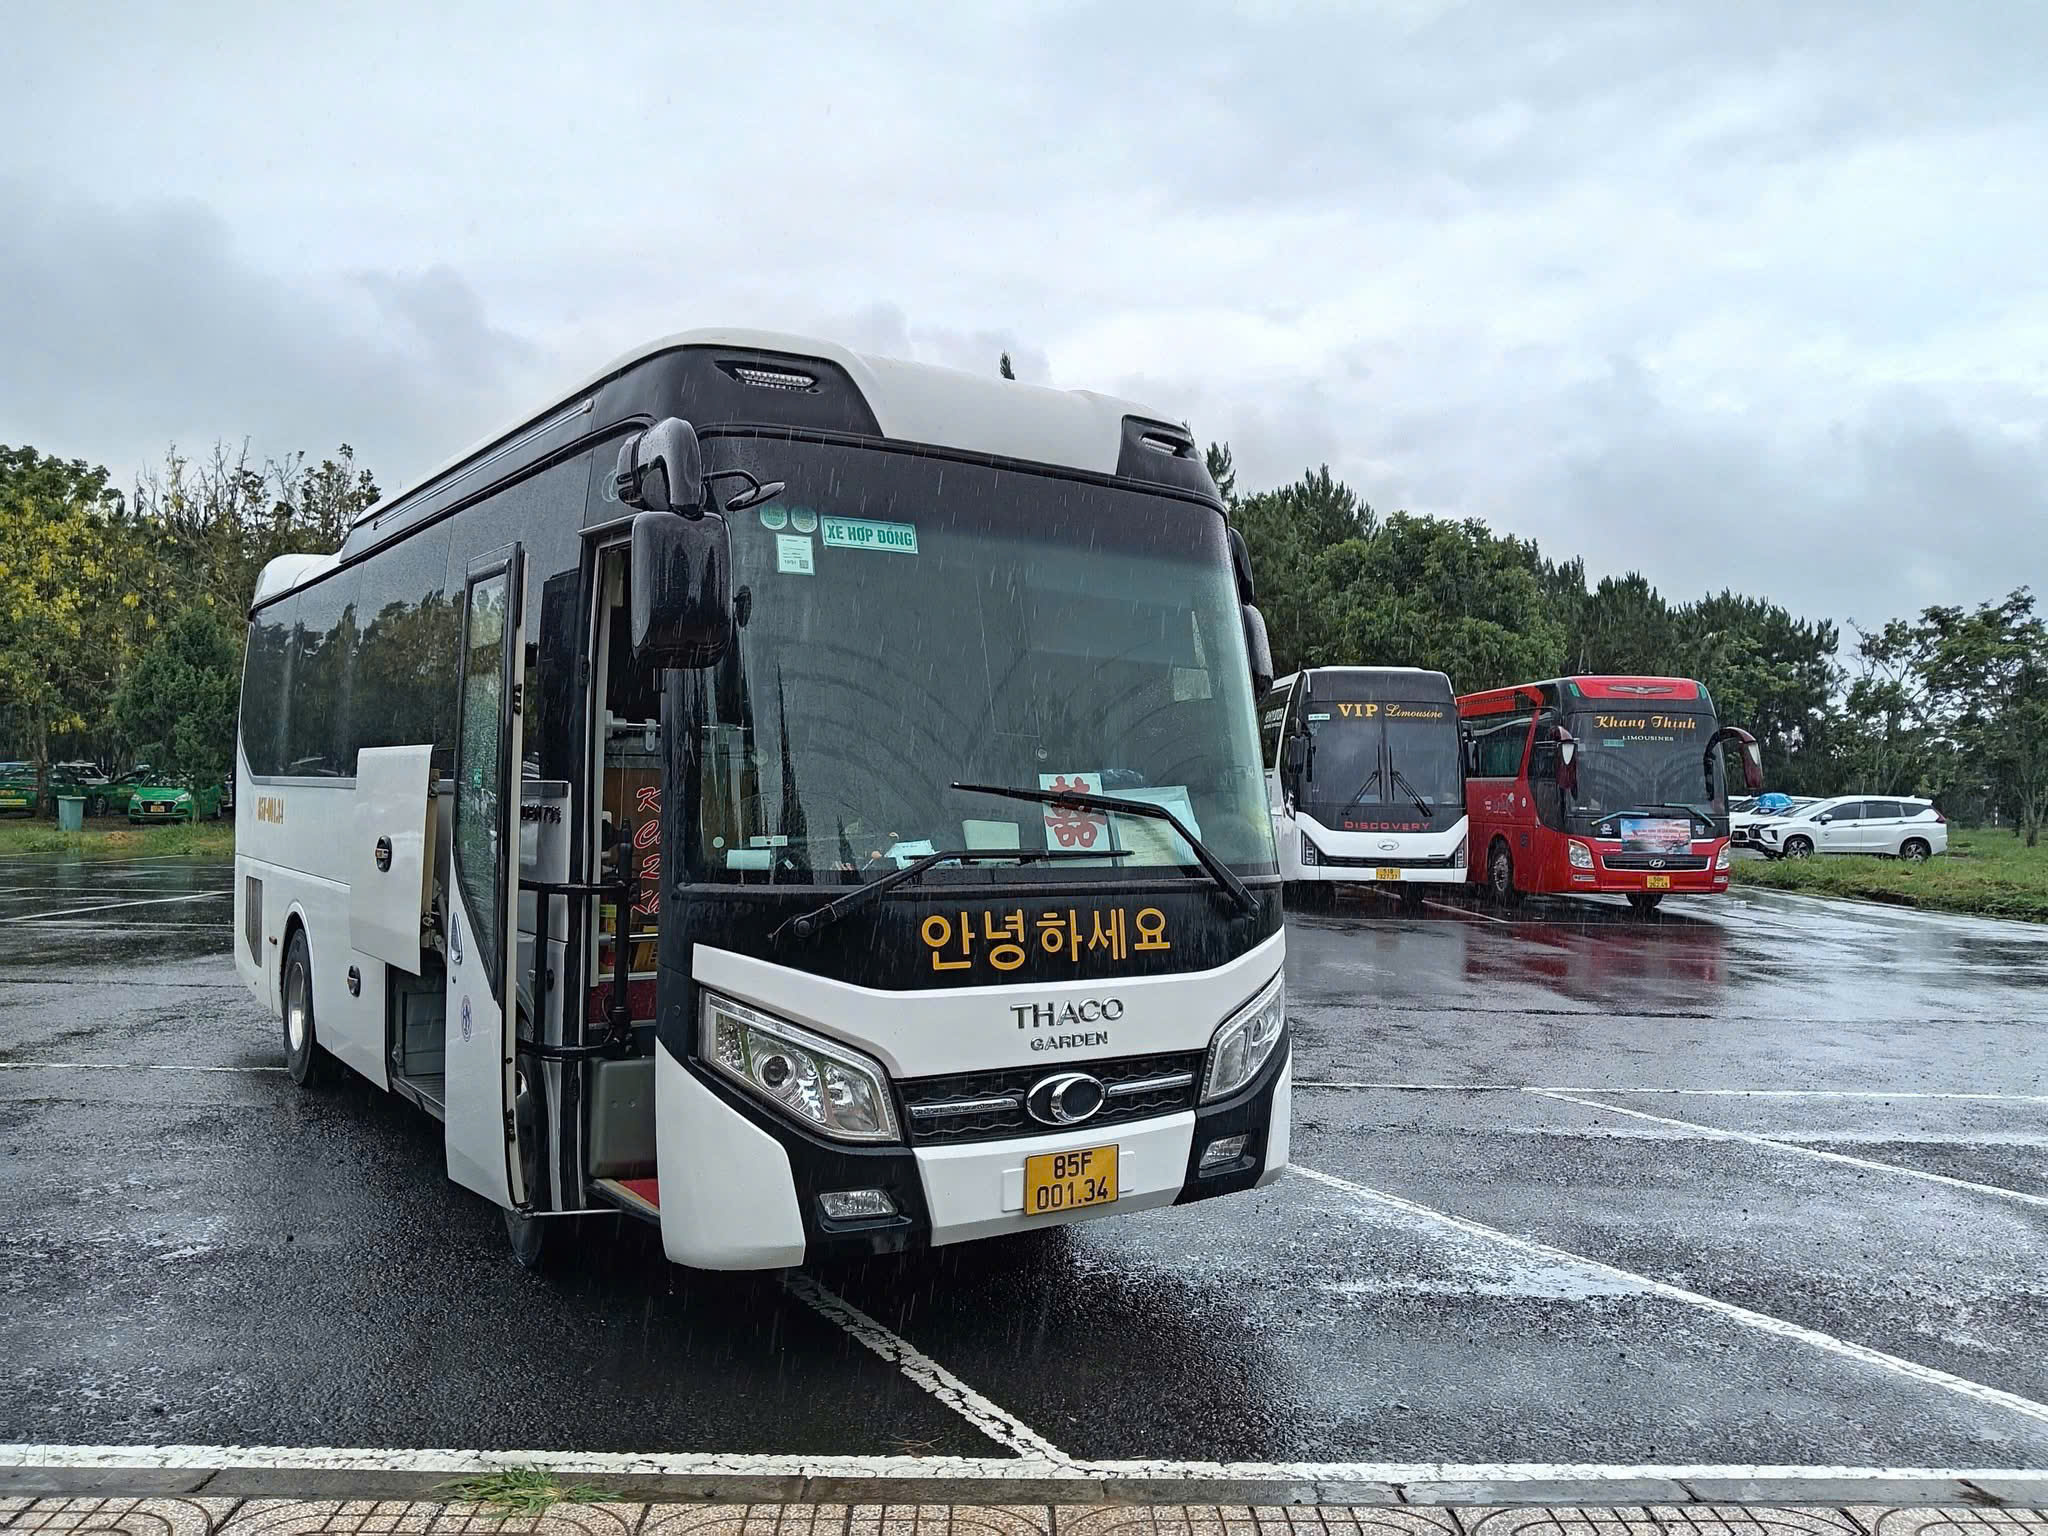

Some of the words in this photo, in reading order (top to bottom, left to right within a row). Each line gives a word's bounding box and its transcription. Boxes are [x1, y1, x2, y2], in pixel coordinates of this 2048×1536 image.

[827, 524, 844, 540] XE
[848, 526, 873, 544] HỢP
[1337, 703, 1379, 718] VIP
[1384, 703, 1444, 719] Limousine
[1593, 715, 1645, 730] Khang
[1344, 821, 1430, 831] DISCOVERY
[920, 907, 1171, 971] 안녕하세요
[1010, 996, 1124, 1029] THACO
[1030, 1031, 1108, 1051] GARDEN
[1054, 1151, 1093, 1179] 85F
[1036, 1176, 1109, 1210] 001.34
